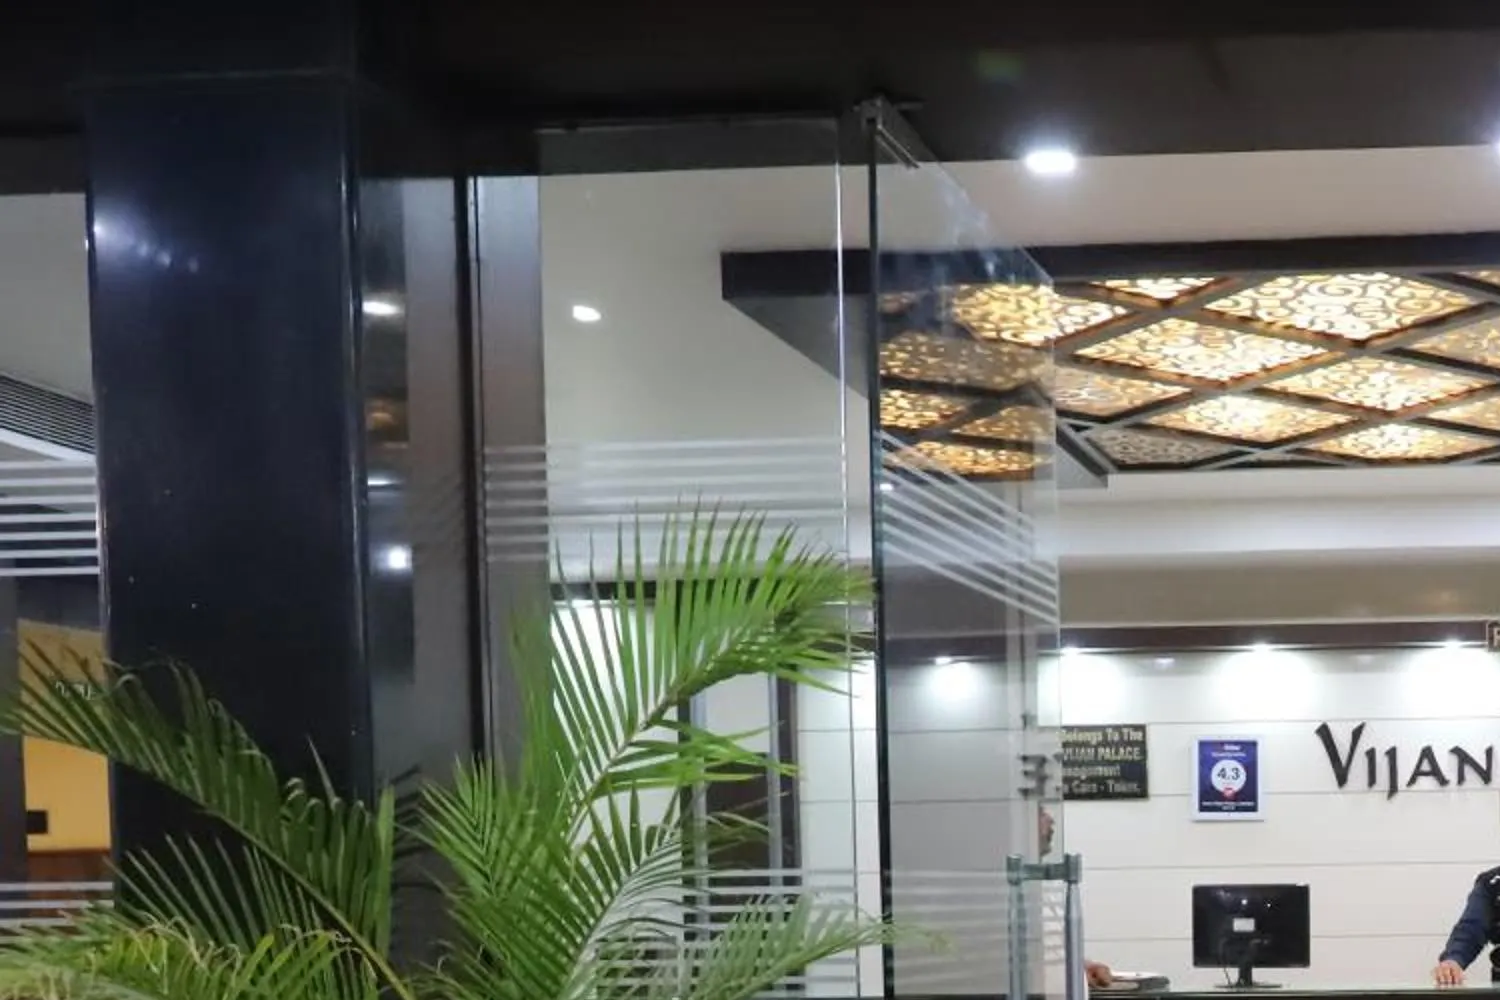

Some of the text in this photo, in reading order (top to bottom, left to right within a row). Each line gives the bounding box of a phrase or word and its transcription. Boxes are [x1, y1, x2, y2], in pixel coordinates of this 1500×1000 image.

[1106, 728, 1119, 741] To
[1121, 727, 1143, 741] The
[1315, 721, 1494, 800] VIJAN
[1217, 767, 1241, 781] 4.3
